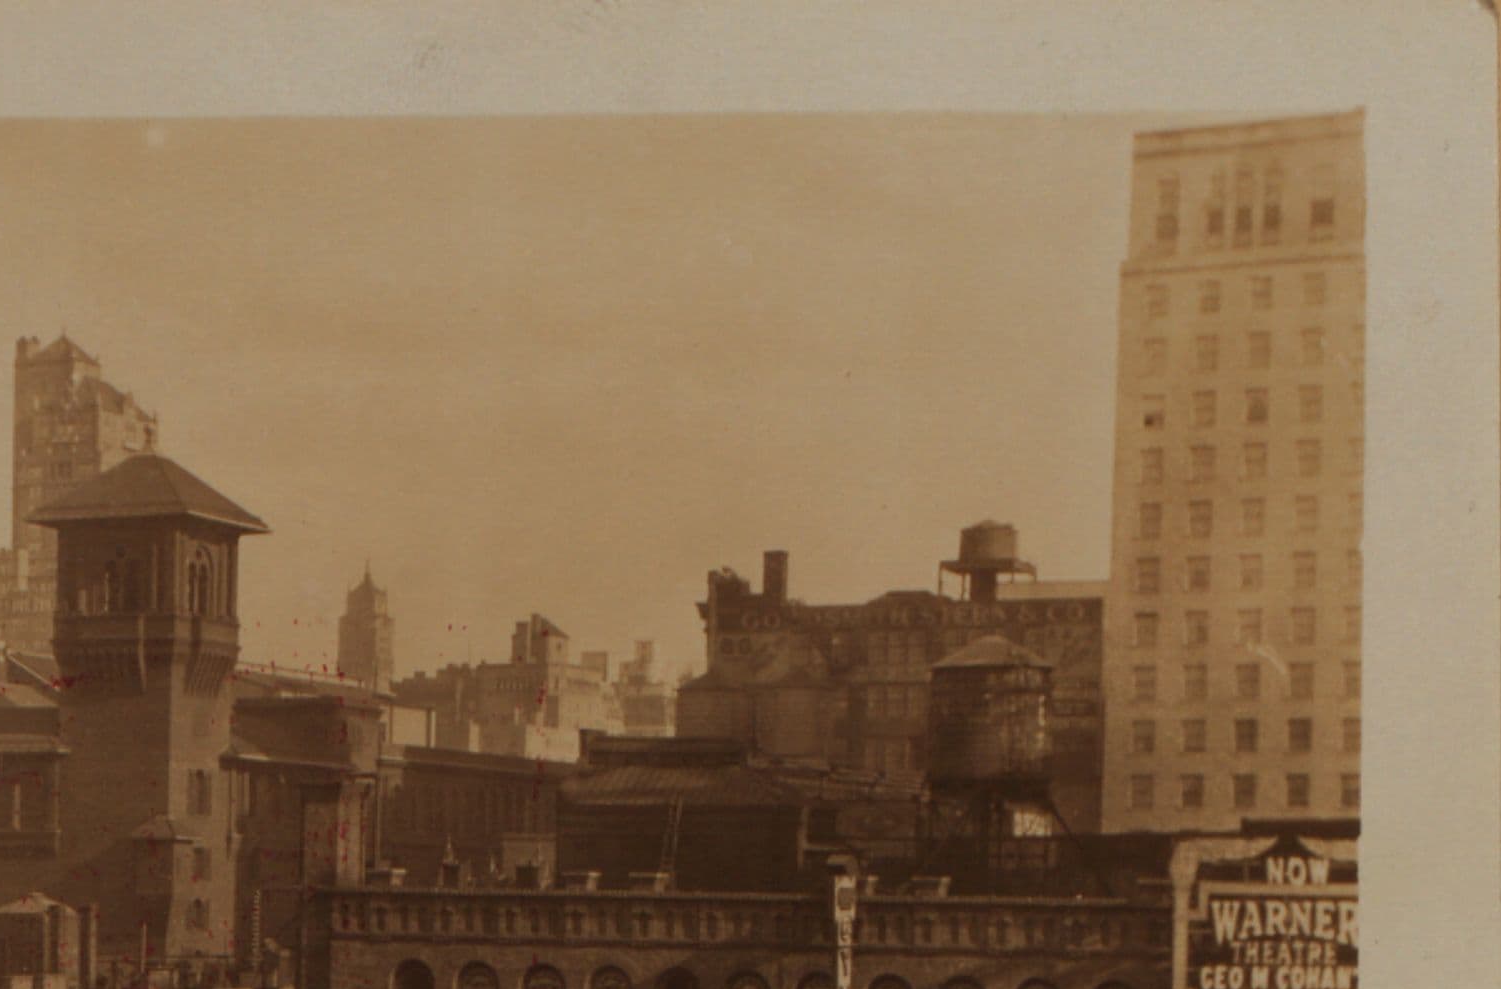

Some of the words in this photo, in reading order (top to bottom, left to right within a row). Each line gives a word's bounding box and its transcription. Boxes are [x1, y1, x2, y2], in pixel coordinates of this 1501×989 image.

[1266, 856, 1329, 885] NOW
[1211, 900, 1358, 946] WARNER
[1230, 941, 1337, 966] THEATRE
